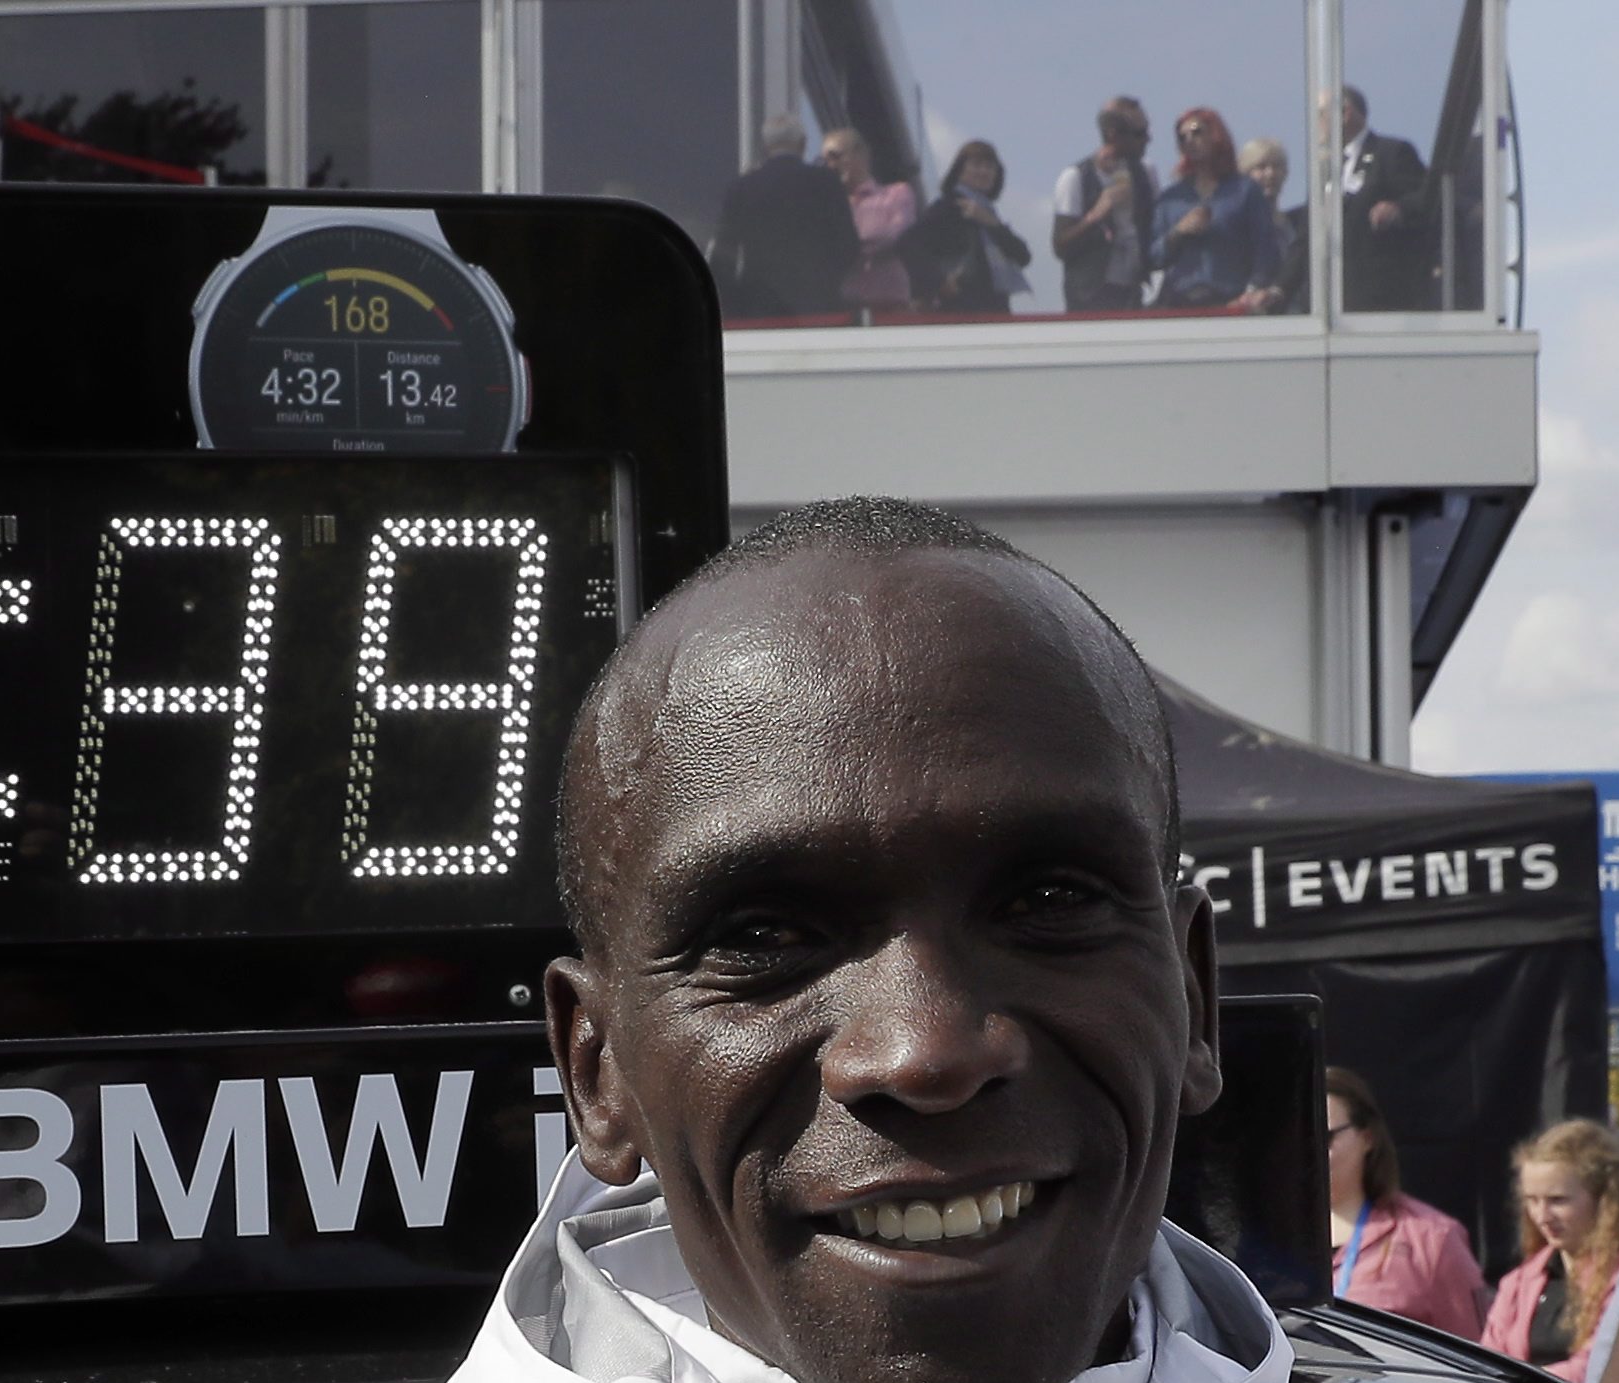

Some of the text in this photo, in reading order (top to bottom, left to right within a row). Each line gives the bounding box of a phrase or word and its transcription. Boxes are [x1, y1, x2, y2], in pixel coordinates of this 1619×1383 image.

[324, 295, 390, 333] 168
[283, 349, 315, 363] Pace
[386, 350, 441, 365] Distance
[260, 367, 342, 405] 4:32
[379, 370, 457, 408] 13.42
[276, 409, 324, 424] min/km
[405, 411, 425, 425] km
[1288, 843, 1559, 908] EVENTS
